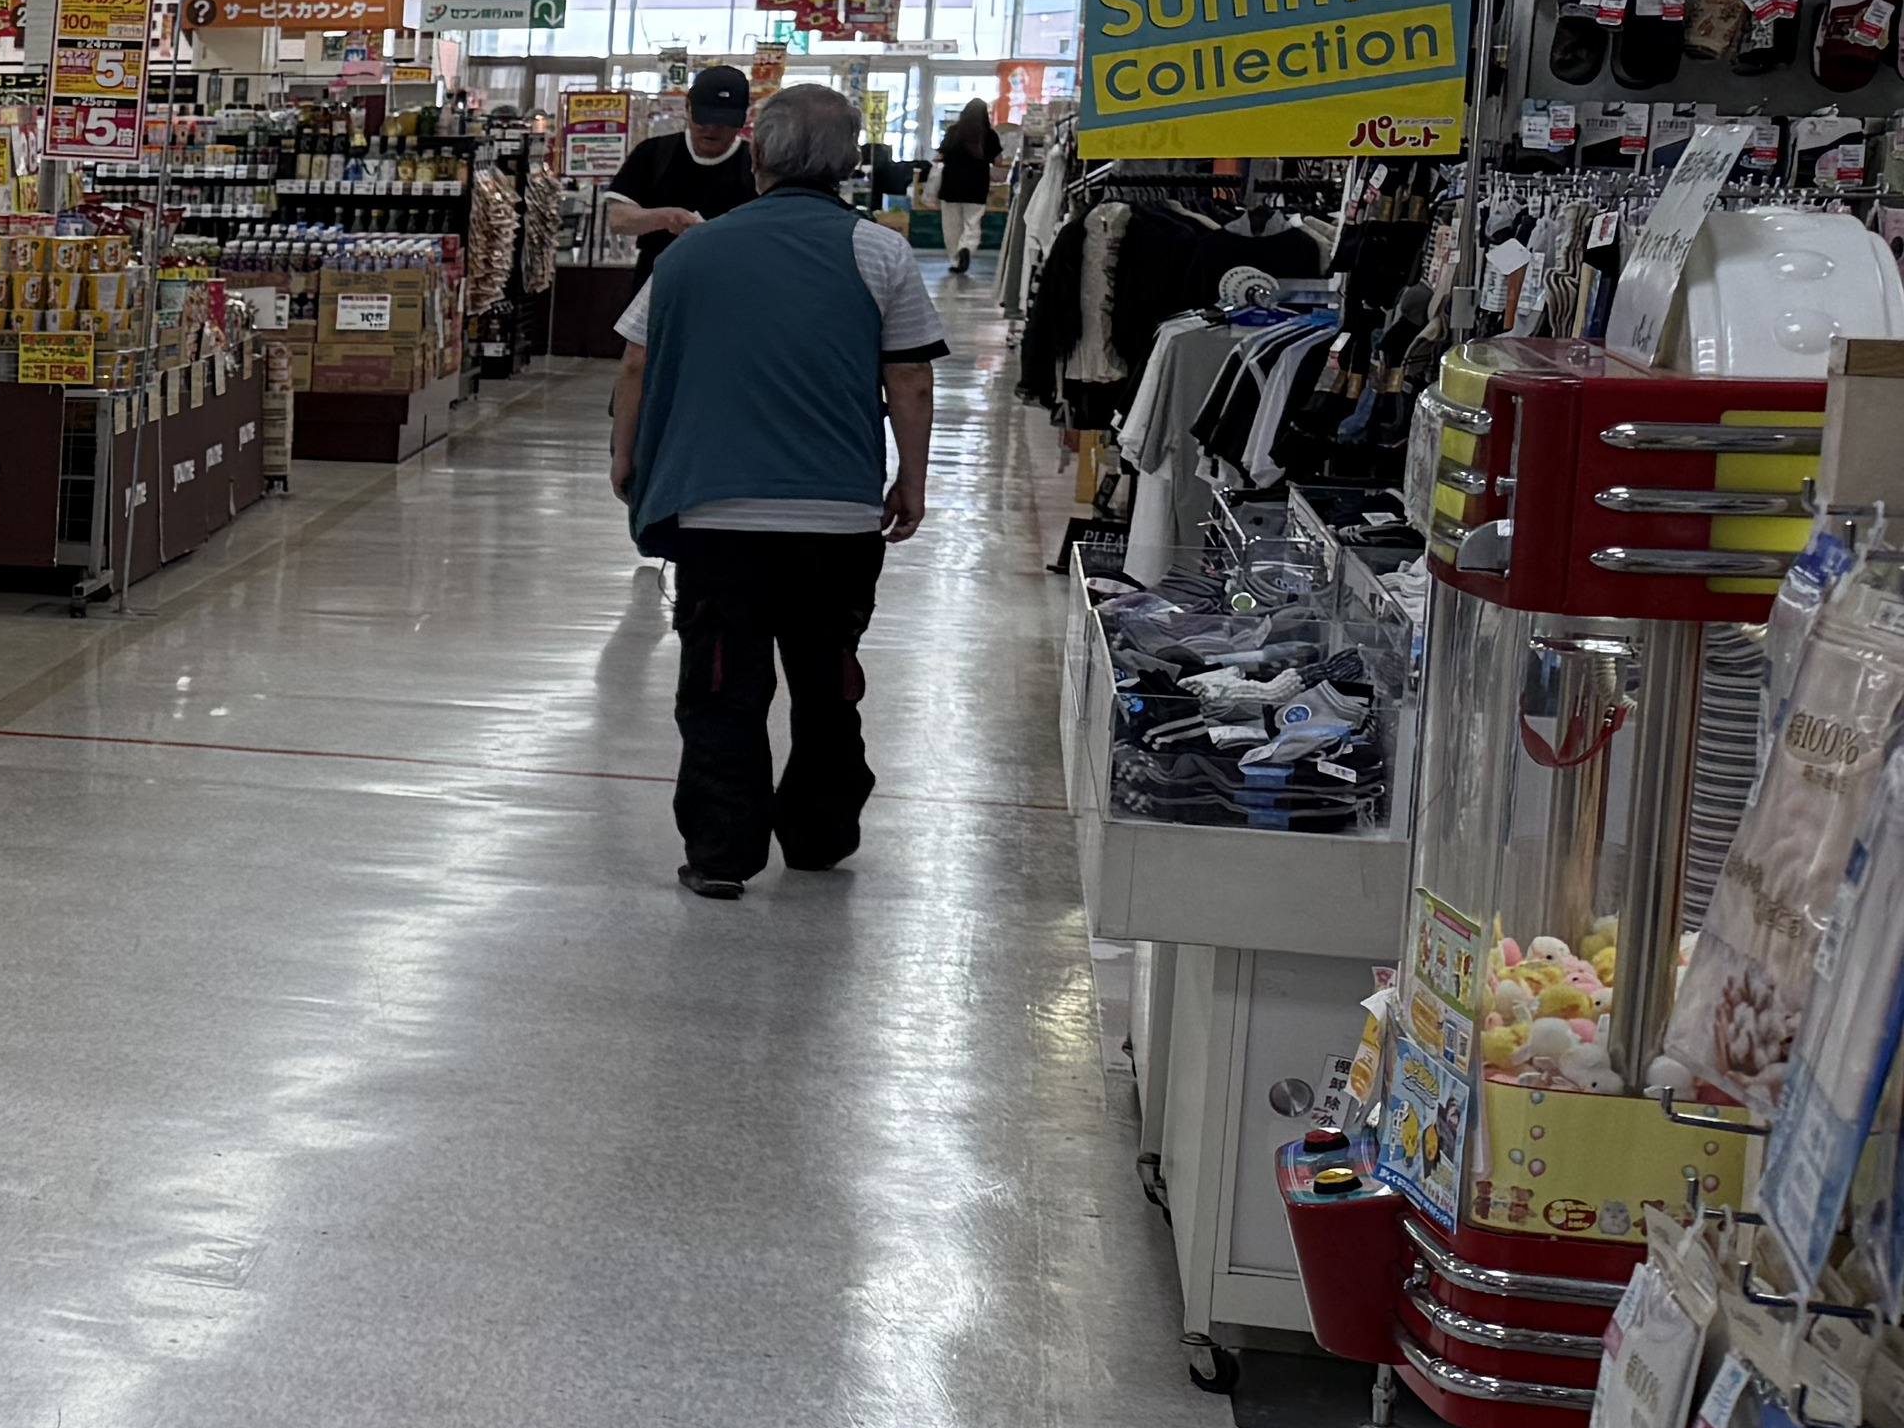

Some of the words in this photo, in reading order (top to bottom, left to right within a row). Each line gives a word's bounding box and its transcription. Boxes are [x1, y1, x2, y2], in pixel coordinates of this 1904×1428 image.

[223, 2, 385, 20] サービスカウンター
[1104, 20, 1439, 103] Collection
[84, 108, 135, 147] 5倍
[1349, 115, 1440, 149] パレット
[1083, 529, 1128, 554] PLEA
